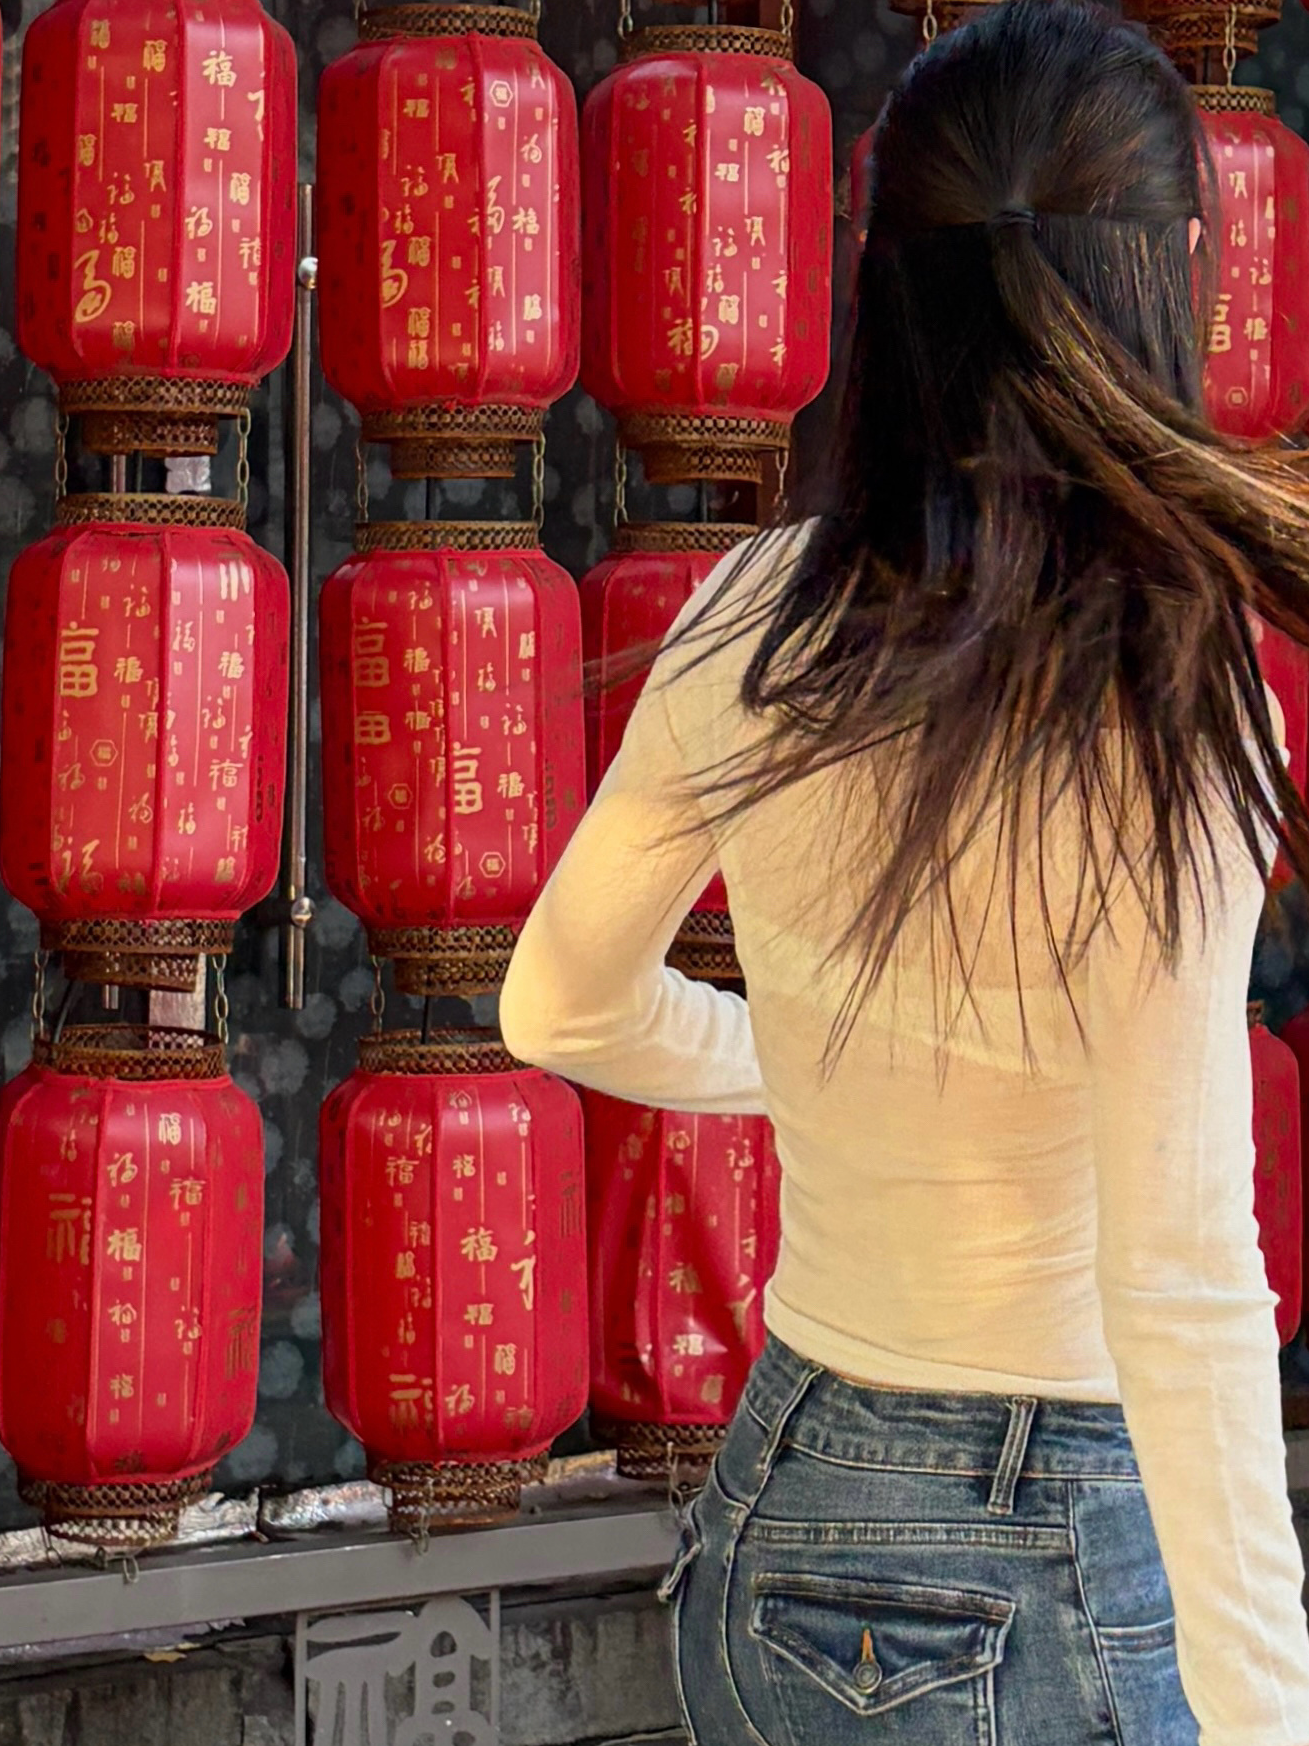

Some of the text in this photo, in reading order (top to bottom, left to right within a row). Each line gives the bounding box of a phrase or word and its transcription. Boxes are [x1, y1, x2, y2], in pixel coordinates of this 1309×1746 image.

[203, 51, 236, 87] 福
[186, 279, 217, 316] 福
[107, 1229, 141, 1261] 福
[460, 1226, 498, 1262] 福
